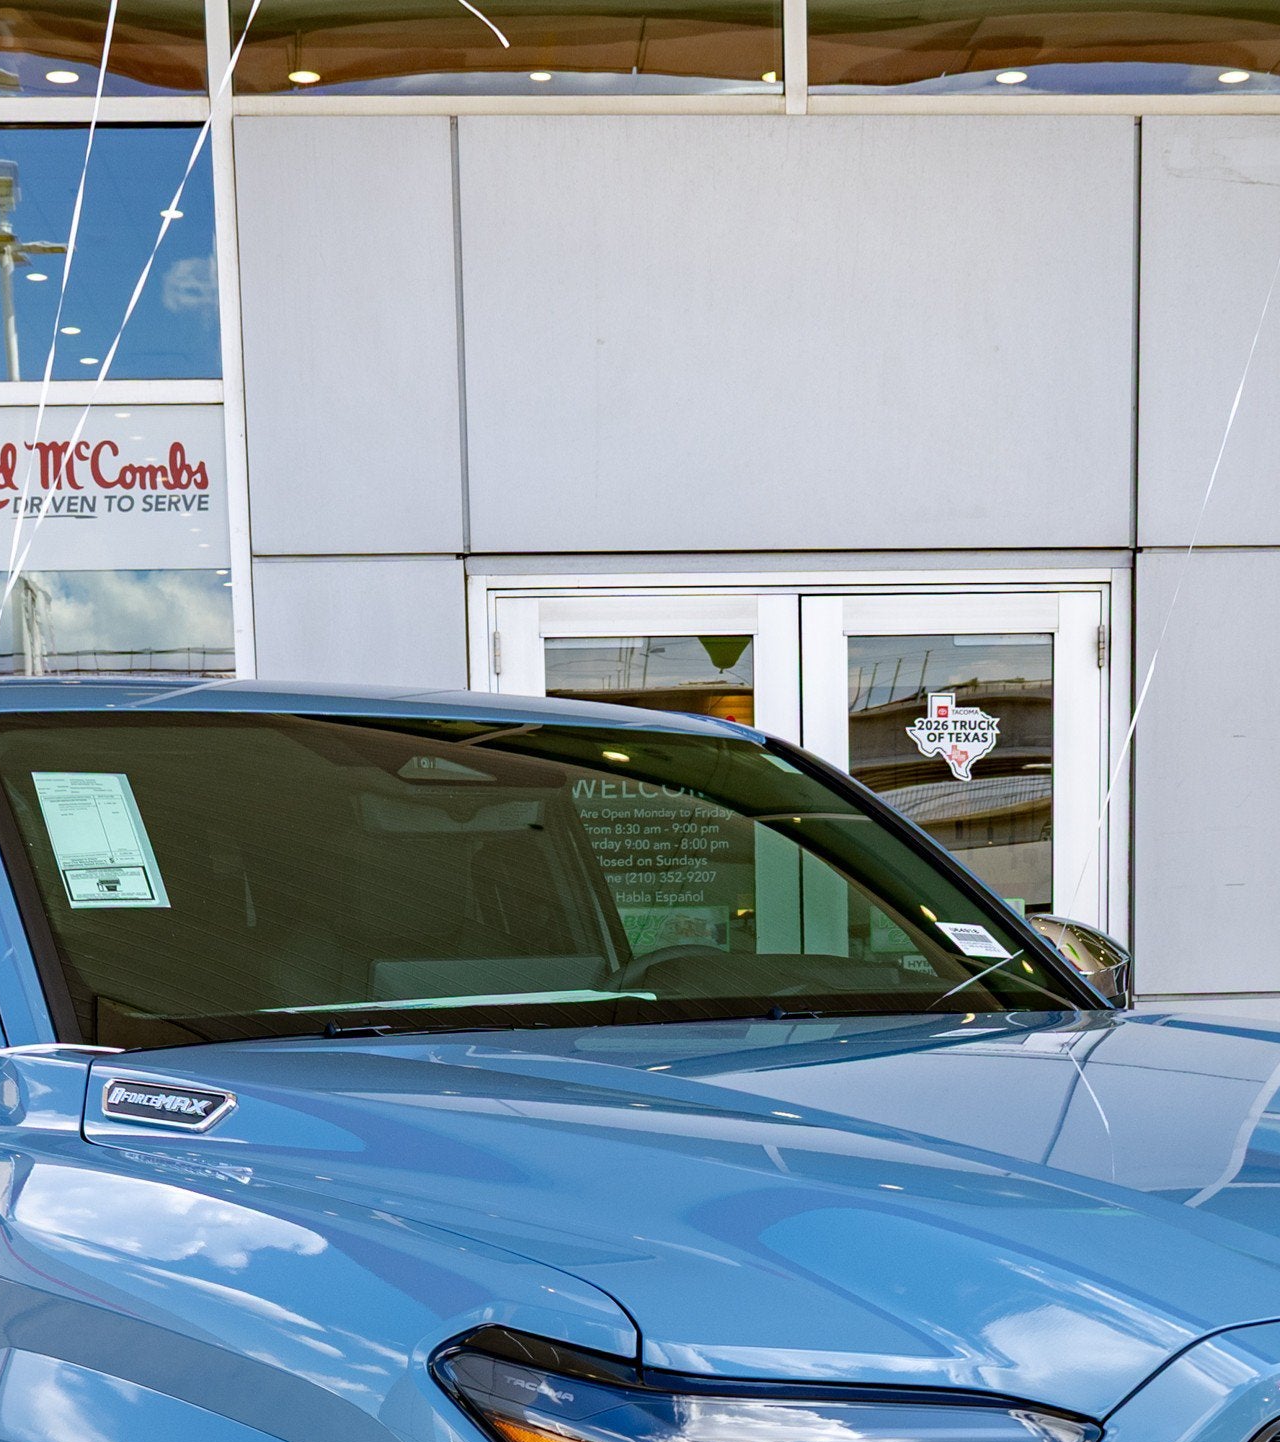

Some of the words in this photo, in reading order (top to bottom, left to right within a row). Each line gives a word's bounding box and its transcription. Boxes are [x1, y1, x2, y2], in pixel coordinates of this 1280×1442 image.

[24, 440, 209, 490] McCombs
[13, 495, 97, 514] DRVEN
[104, 495, 135, 513] TO
[141, 494, 210, 512] SERVE
[917, 720, 949, 731] 2026
[952, 720, 996, 731] TRUCK
[927, 732, 944, 742] OF
[947, 732, 988, 742] TEXAS
[572, 779, 704, 799] WELCO
[580, 809, 599, 819] Are
[602, 809, 631, 821] Open
[634, 808, 677, 820] Monday
[680, 808, 691, 818] to
[695, 807, 736, 820] Friday
[615, 824, 641, 834] 8:30
[644, 826, 662, 834] am
[672, 823, 698, 833] 9:00
[701, 824, 720, 835] pm
[625, 839, 650, 850] 9:00
[654, 841, 671, 850] am
[681, 838, 707, 849] 8:00
[710, 840, 730, 852] pm
[596, 855, 633, 867] losed
[637, 857, 653, 867] on
[656, 855, 708, 869] Sundays
[625, 872, 656, 885] (210)
[660, 871, 717, 883] 352-9207
[616, 891, 651, 903] Habla
[656, 890, 704, 906] Español
